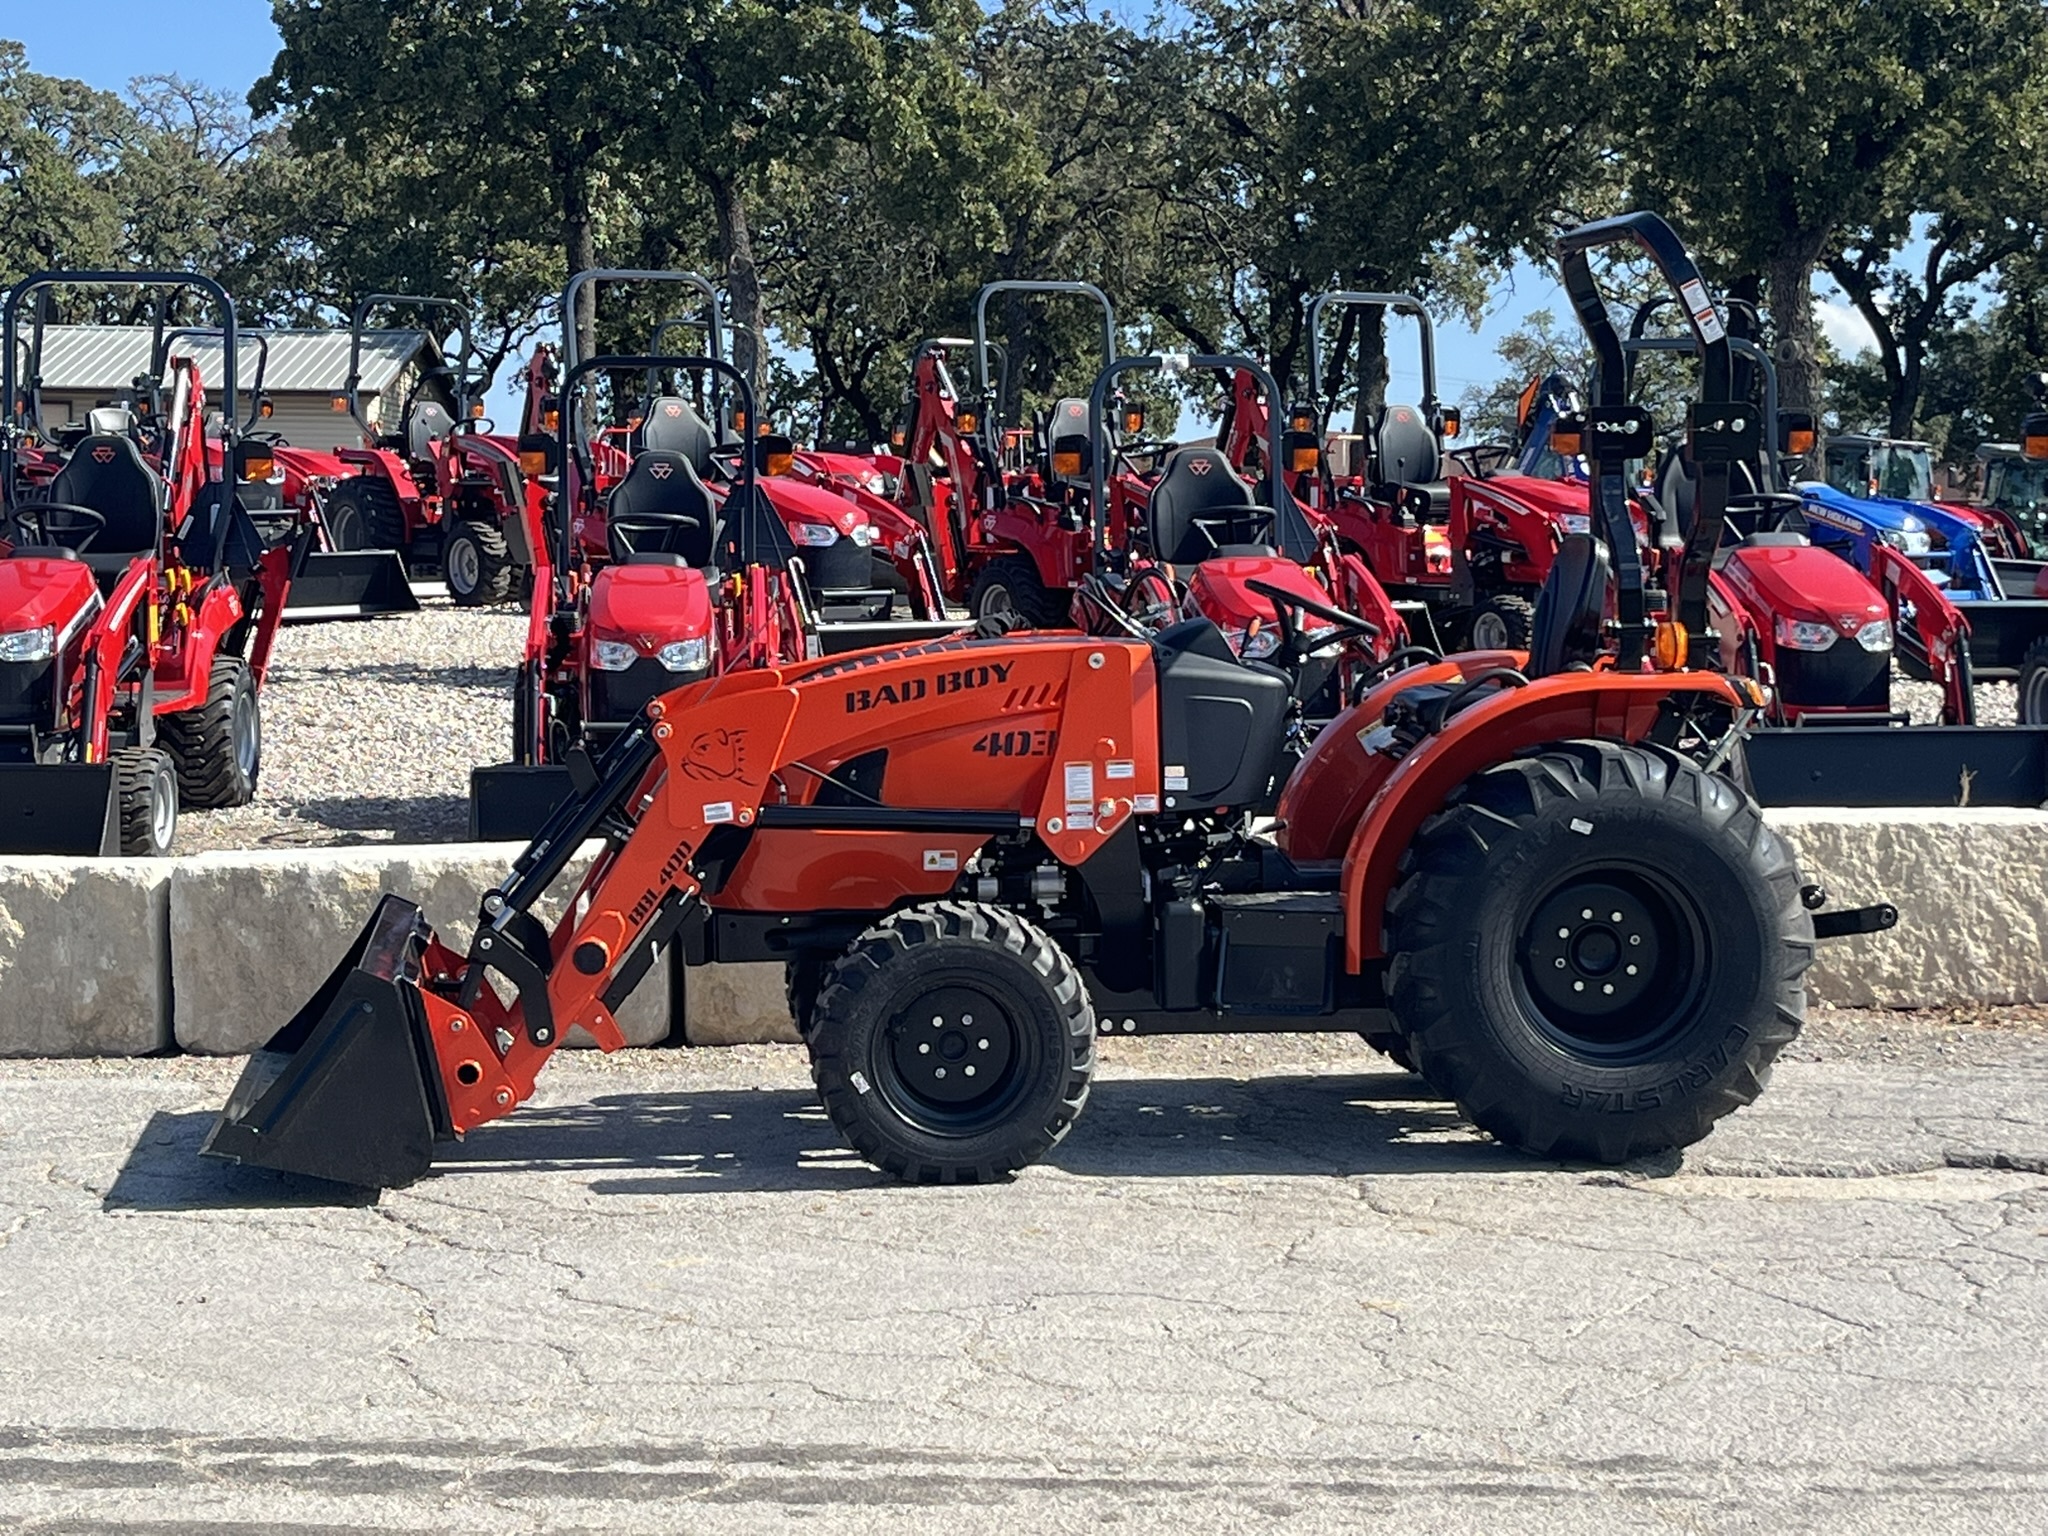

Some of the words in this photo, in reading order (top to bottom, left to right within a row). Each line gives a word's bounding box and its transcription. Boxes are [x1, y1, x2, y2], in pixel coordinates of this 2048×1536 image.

[845, 679, 926, 713] BAD
[936, 660, 1016, 696] BOY
[628, 888, 662, 926] BBL
[660, 841, 692, 885] 400
[1559, 1022, 1750, 1115] CARLSTAR
